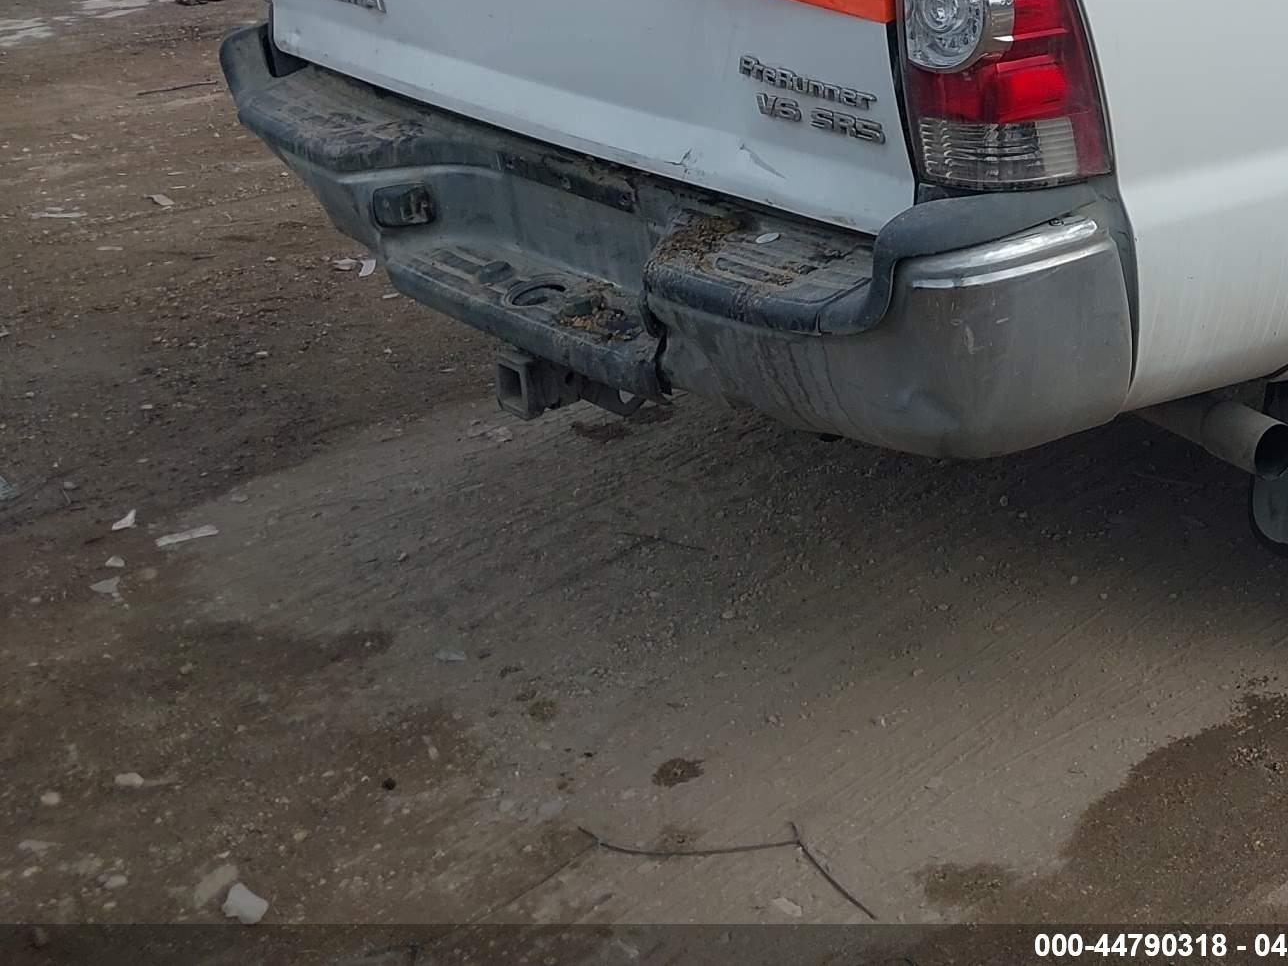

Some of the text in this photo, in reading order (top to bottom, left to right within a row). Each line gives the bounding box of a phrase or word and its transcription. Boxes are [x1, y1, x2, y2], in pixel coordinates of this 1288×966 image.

[739, 54, 877, 110] PreRunner
[756, 92, 886, 145] V6 SR5
